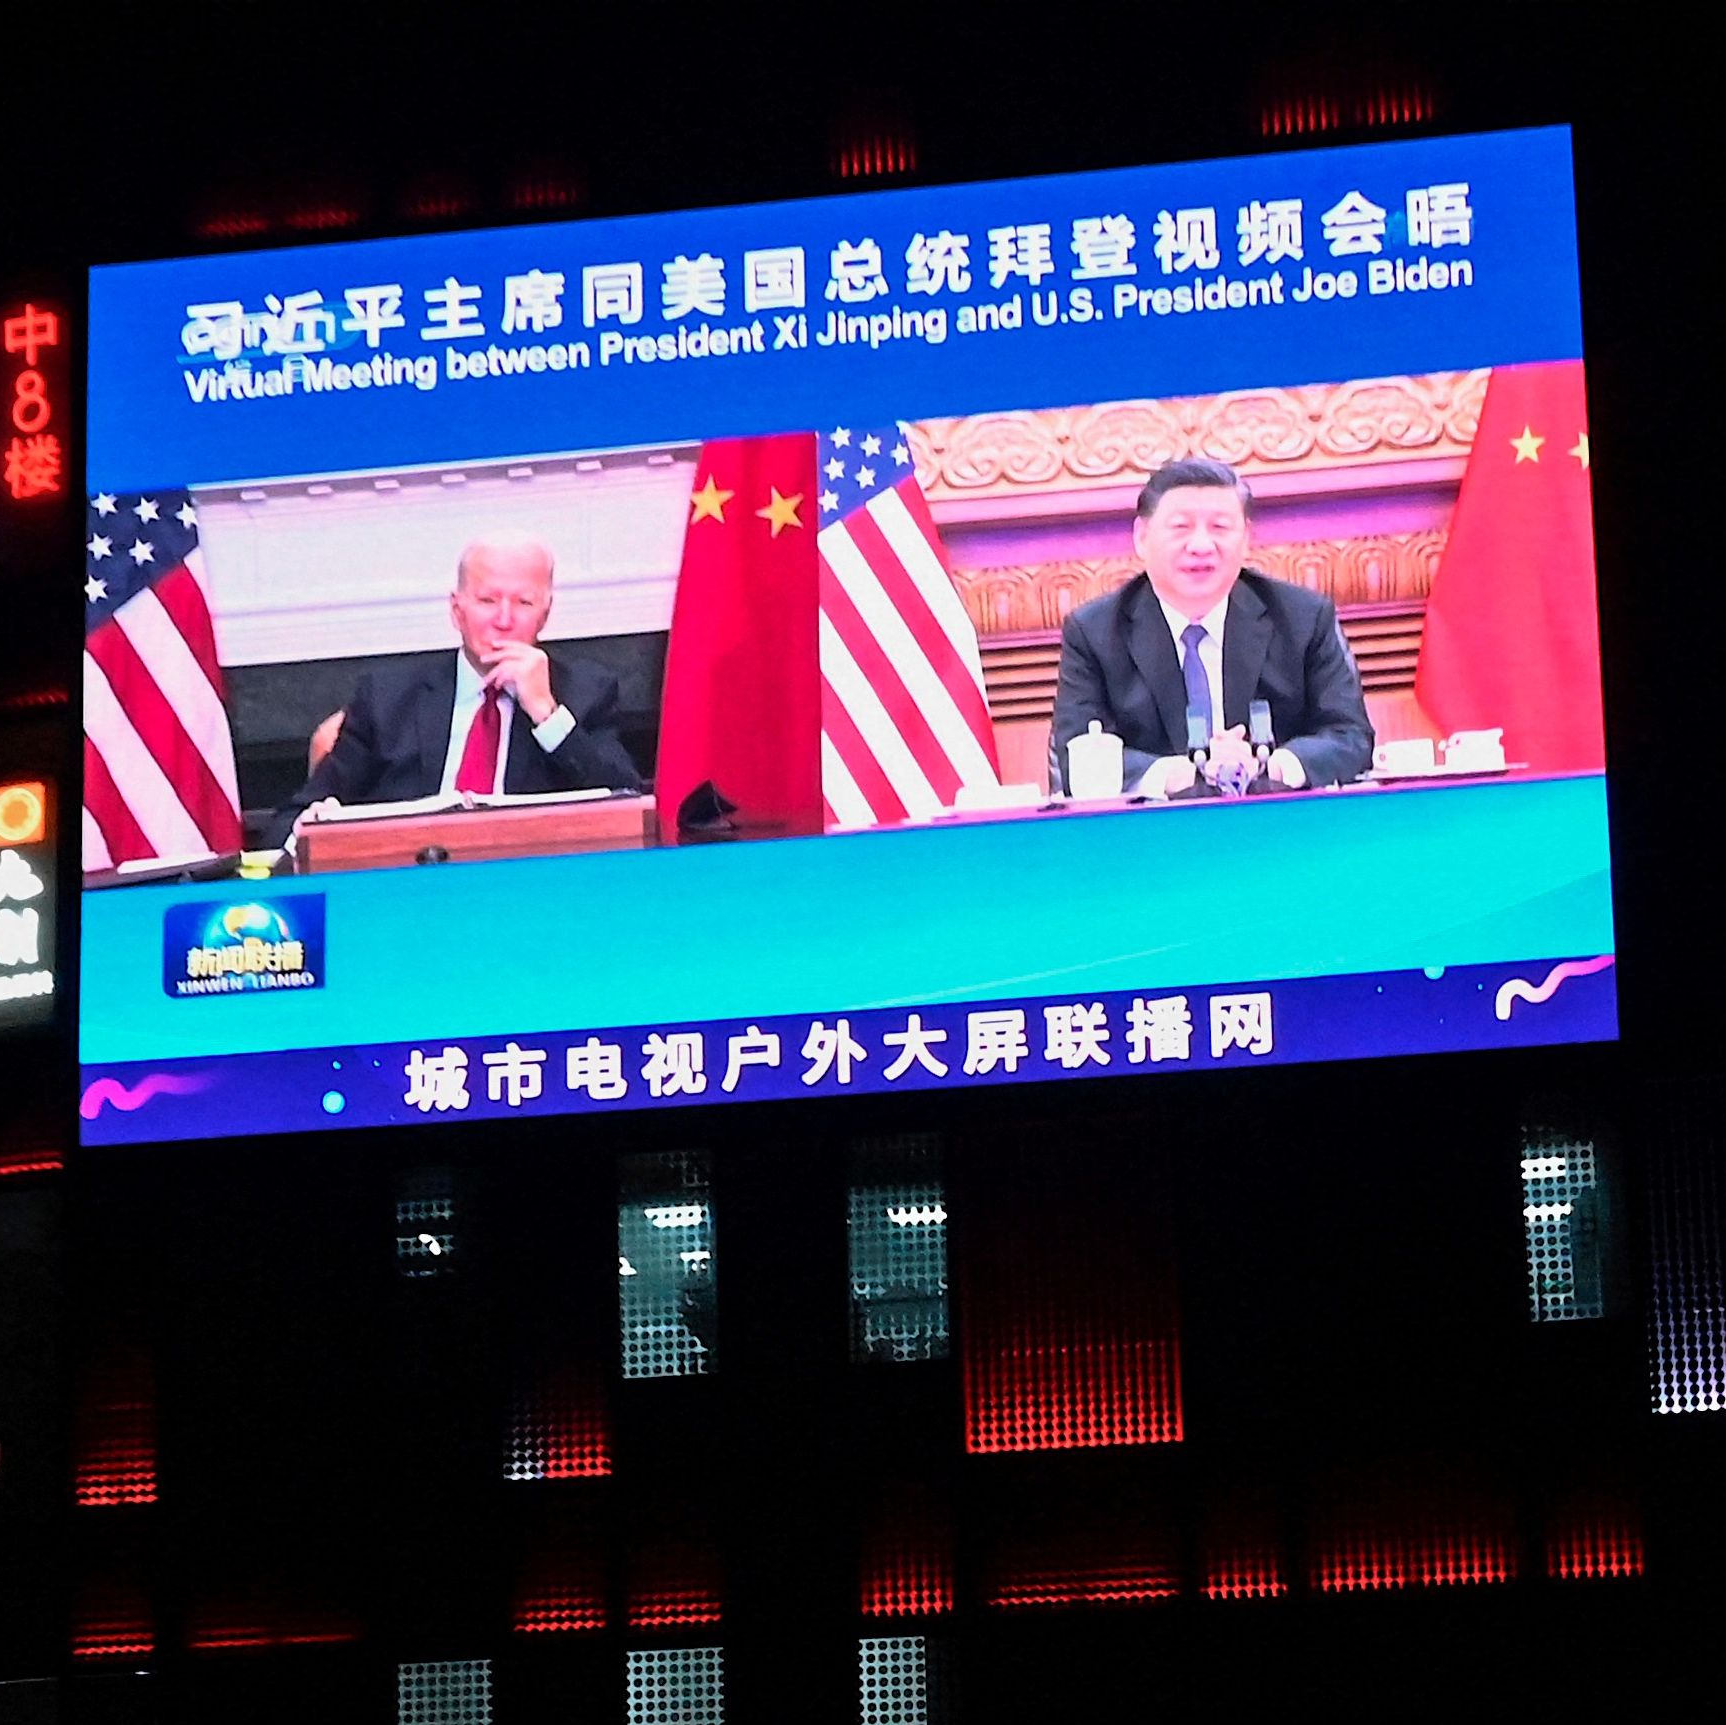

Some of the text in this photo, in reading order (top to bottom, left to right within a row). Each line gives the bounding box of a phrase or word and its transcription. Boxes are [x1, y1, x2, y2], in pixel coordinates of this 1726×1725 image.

[183, 255, 1473, 403] Virtual Meeting between President Xi Jinping and U.S. President Joe Biden
[186, 182, 1473, 360] 习近平主席同美国总统拜登视频会晤
[4, 303, 61, 498] 中8楼
[403, 992, 1275, 1113] 城市电视户外大屏联播网
